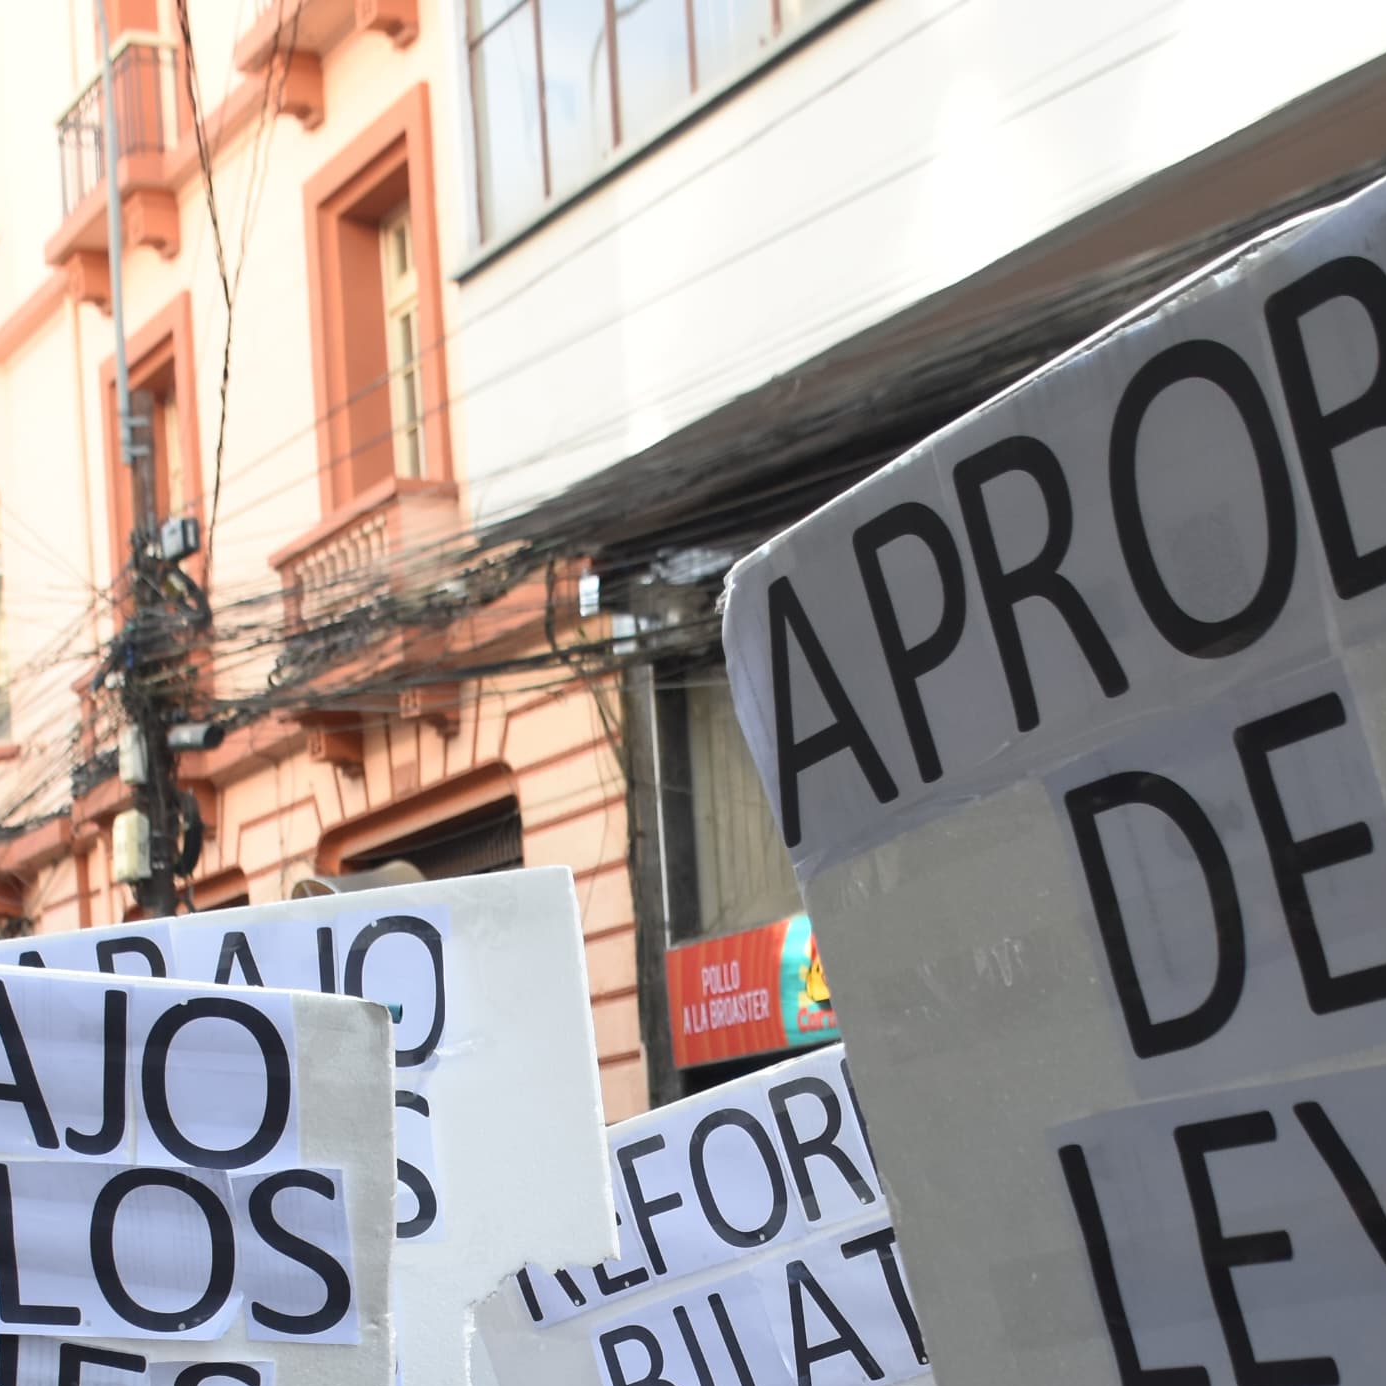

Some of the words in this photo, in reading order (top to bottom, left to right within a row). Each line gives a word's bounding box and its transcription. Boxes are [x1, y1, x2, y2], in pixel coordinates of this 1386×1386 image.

[701, 960, 741, 997] POLLO
[683, 1006, 692, 1035] A
[709, 988, 770, 1030] BROASTER
